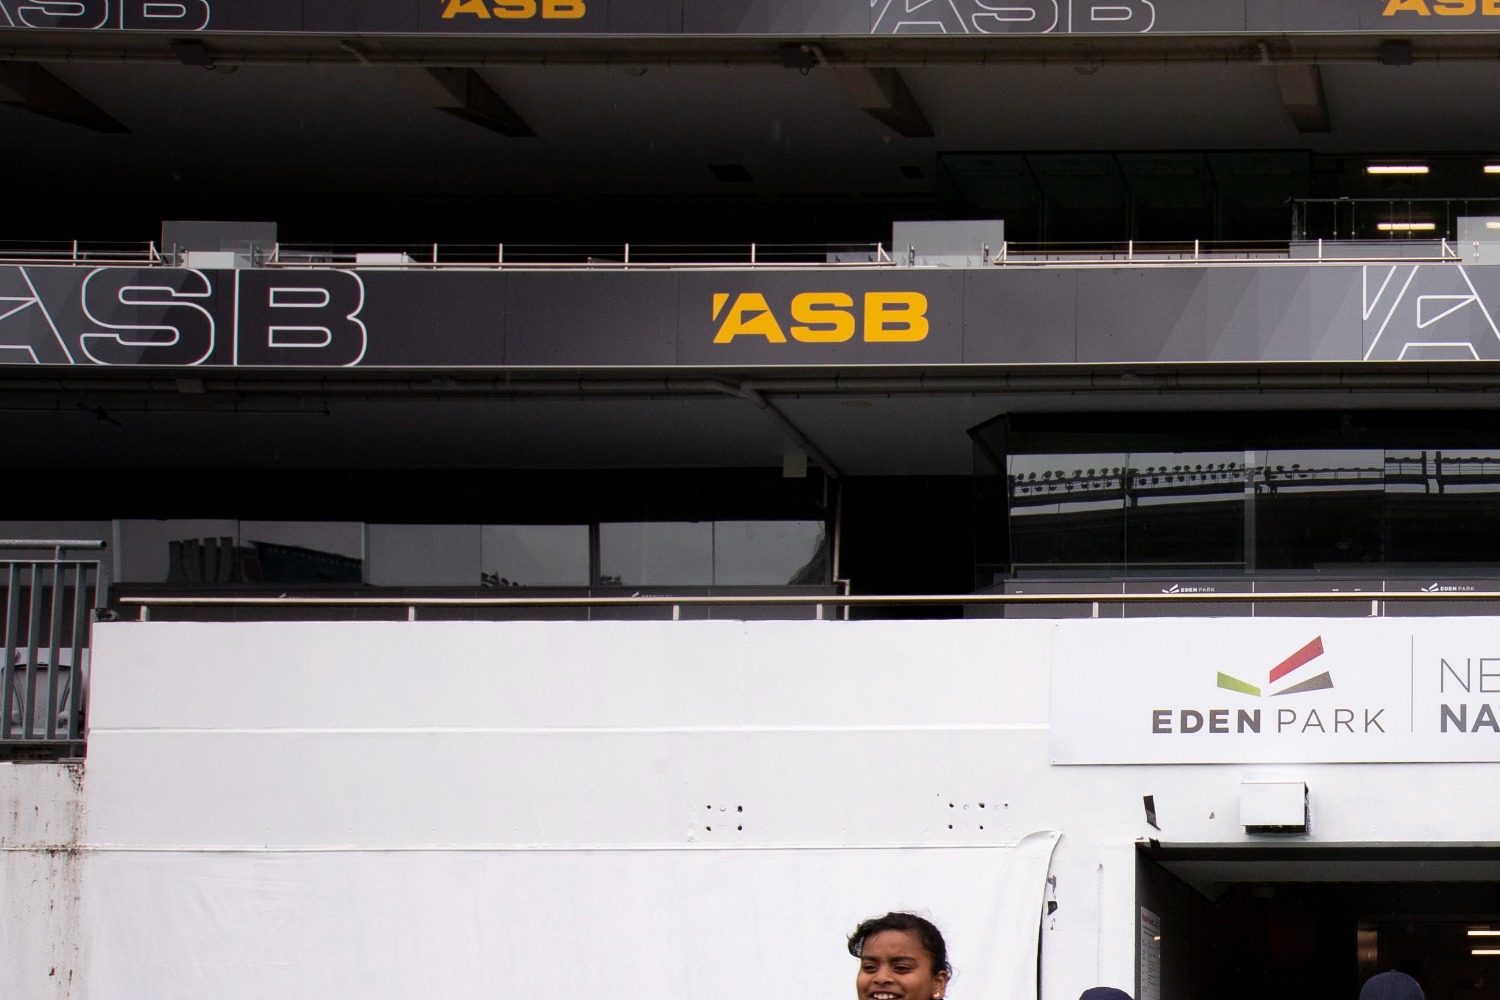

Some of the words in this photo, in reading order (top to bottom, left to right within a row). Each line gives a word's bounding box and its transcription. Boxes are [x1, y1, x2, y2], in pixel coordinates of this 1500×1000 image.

[711, 290, 930, 345] ASB
[1152, 709, 1261, 734] EDEN
[1277, 708, 1385, 733] PARK
